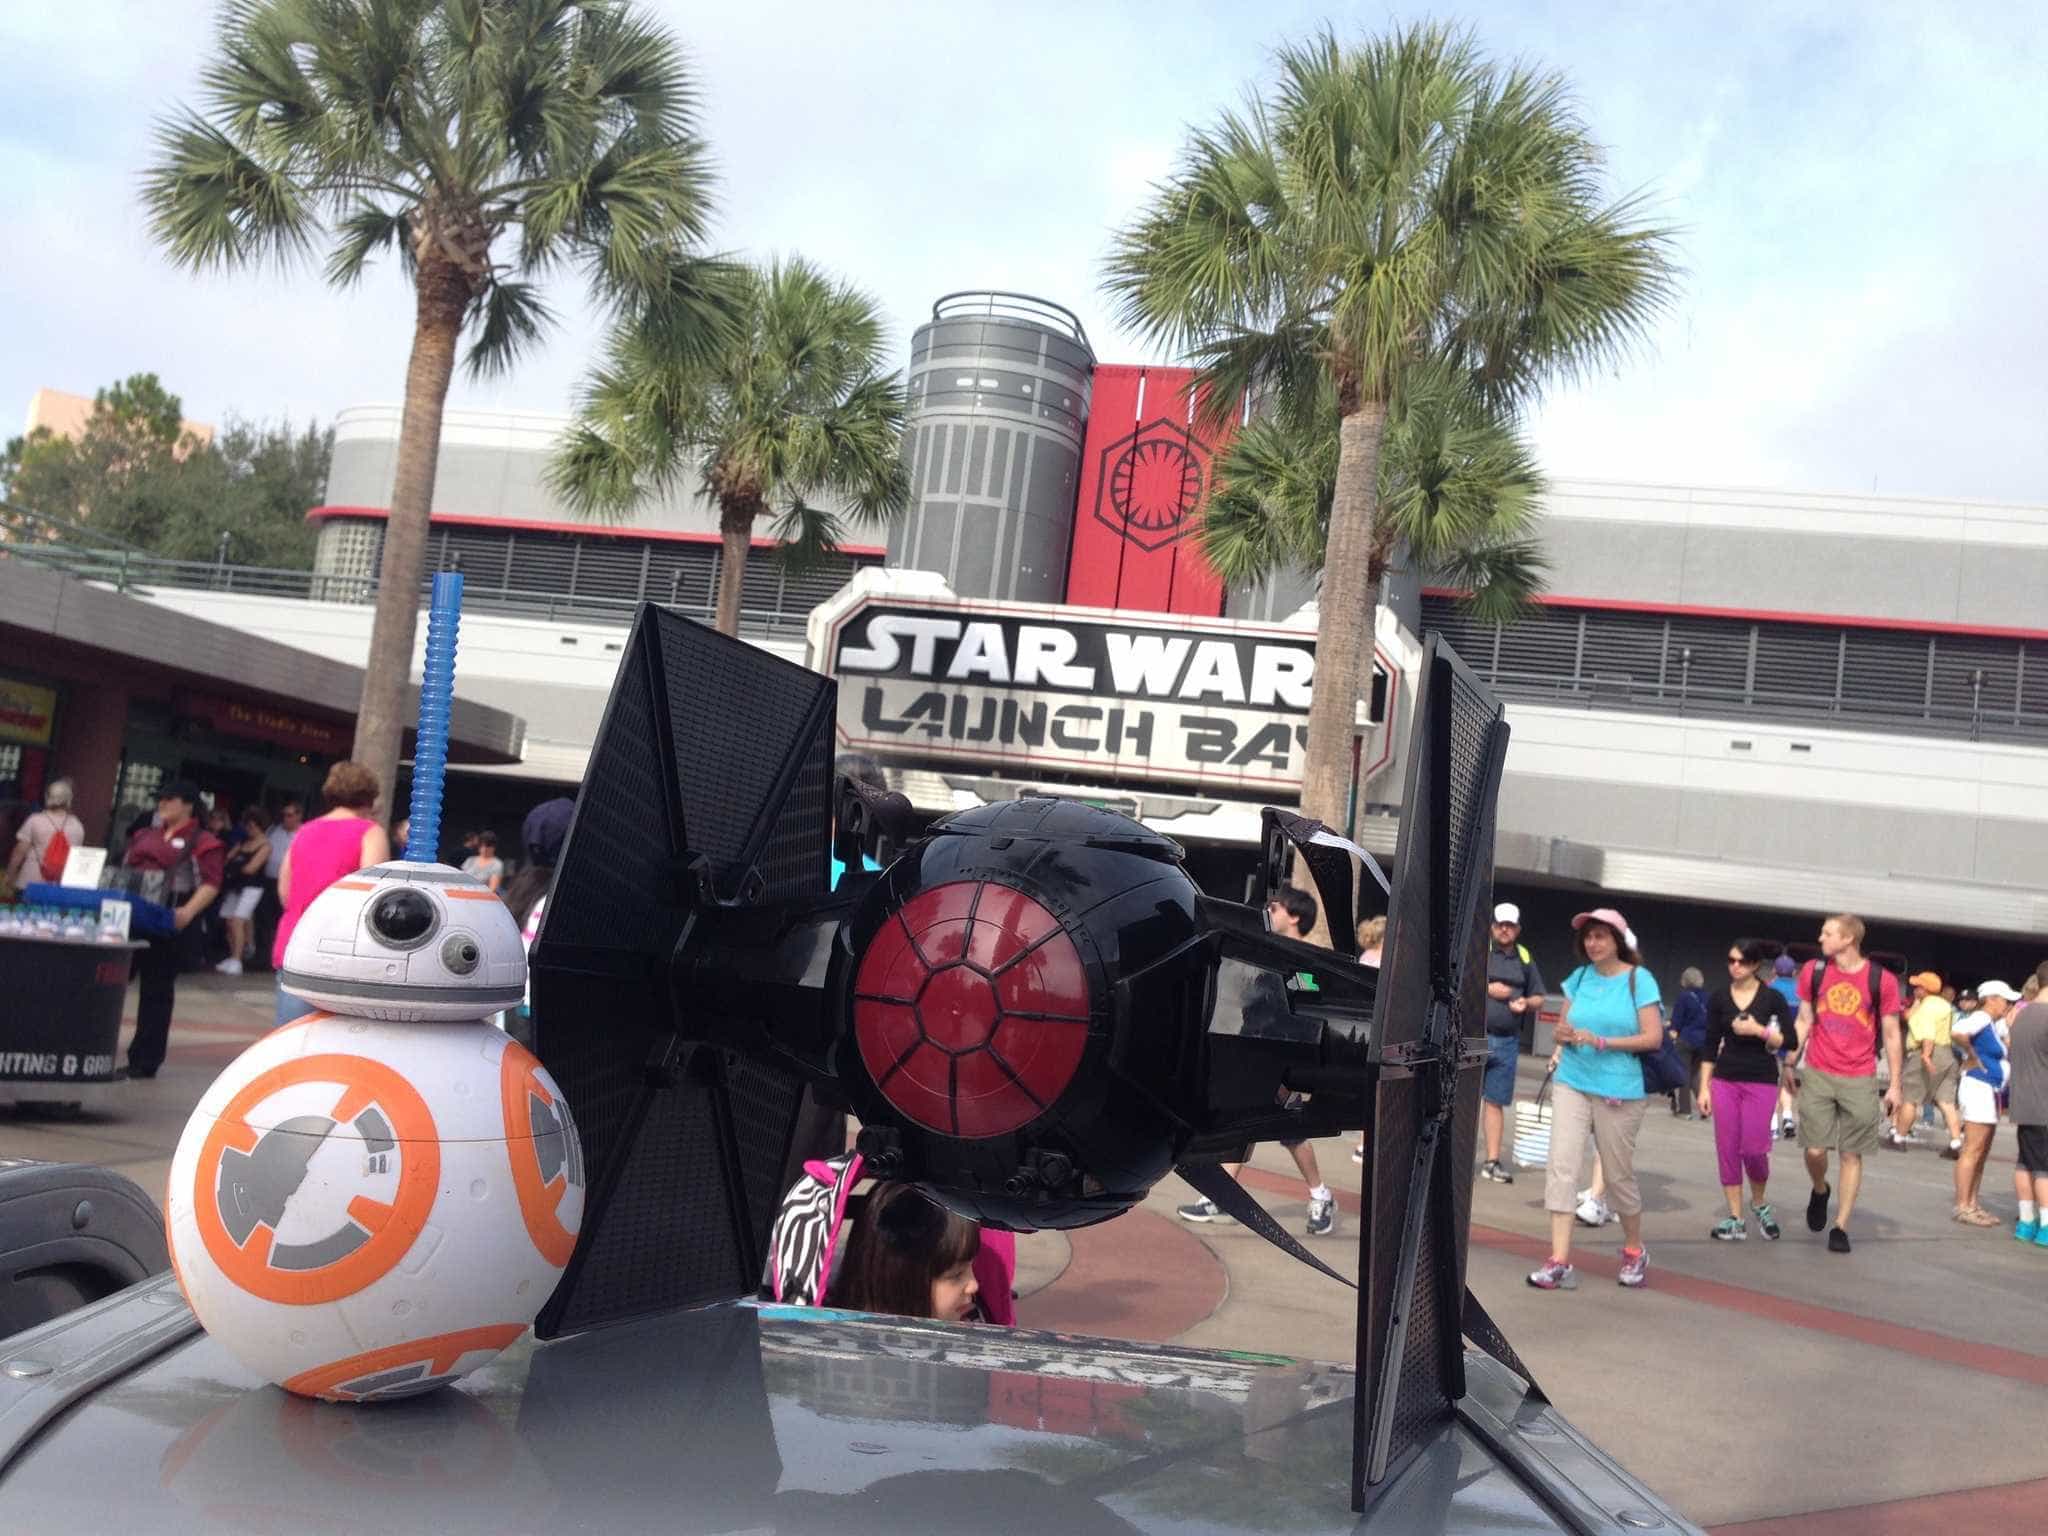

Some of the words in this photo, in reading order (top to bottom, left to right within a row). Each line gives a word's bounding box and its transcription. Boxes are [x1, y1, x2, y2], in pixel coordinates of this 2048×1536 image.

[839, 614, 1097, 691] STAR
[1104, 632, 1384, 709] WAR
[861, 686, 1155, 757] LAUNCH
